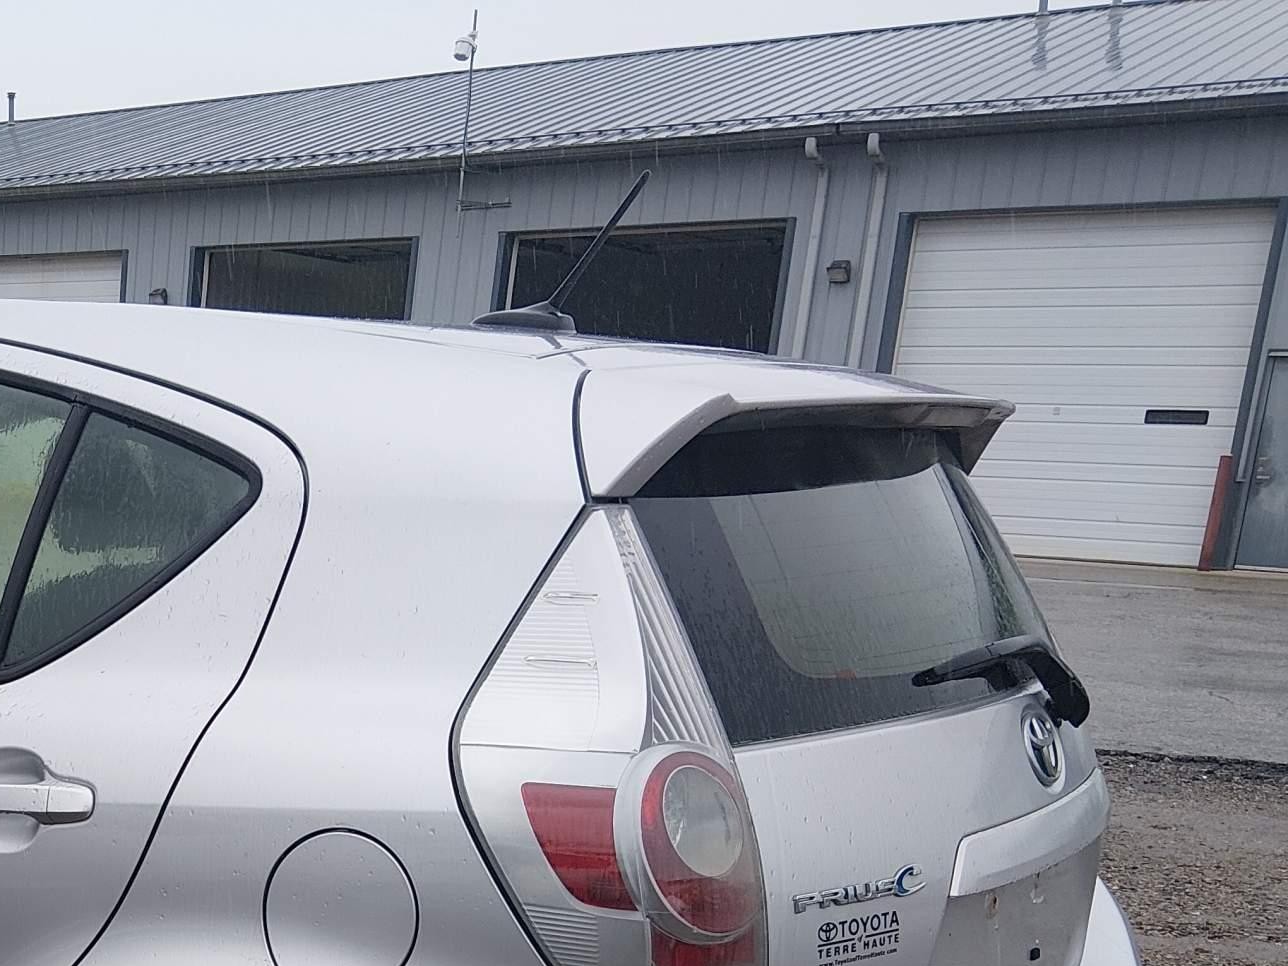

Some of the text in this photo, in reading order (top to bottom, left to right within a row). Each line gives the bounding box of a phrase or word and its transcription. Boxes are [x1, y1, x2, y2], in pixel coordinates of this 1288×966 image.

[792, 878, 895, 915] PRIUS
[839, 911, 900, 938] TOYOTA
[817, 933, 900, 960] TERRE HAUTE
